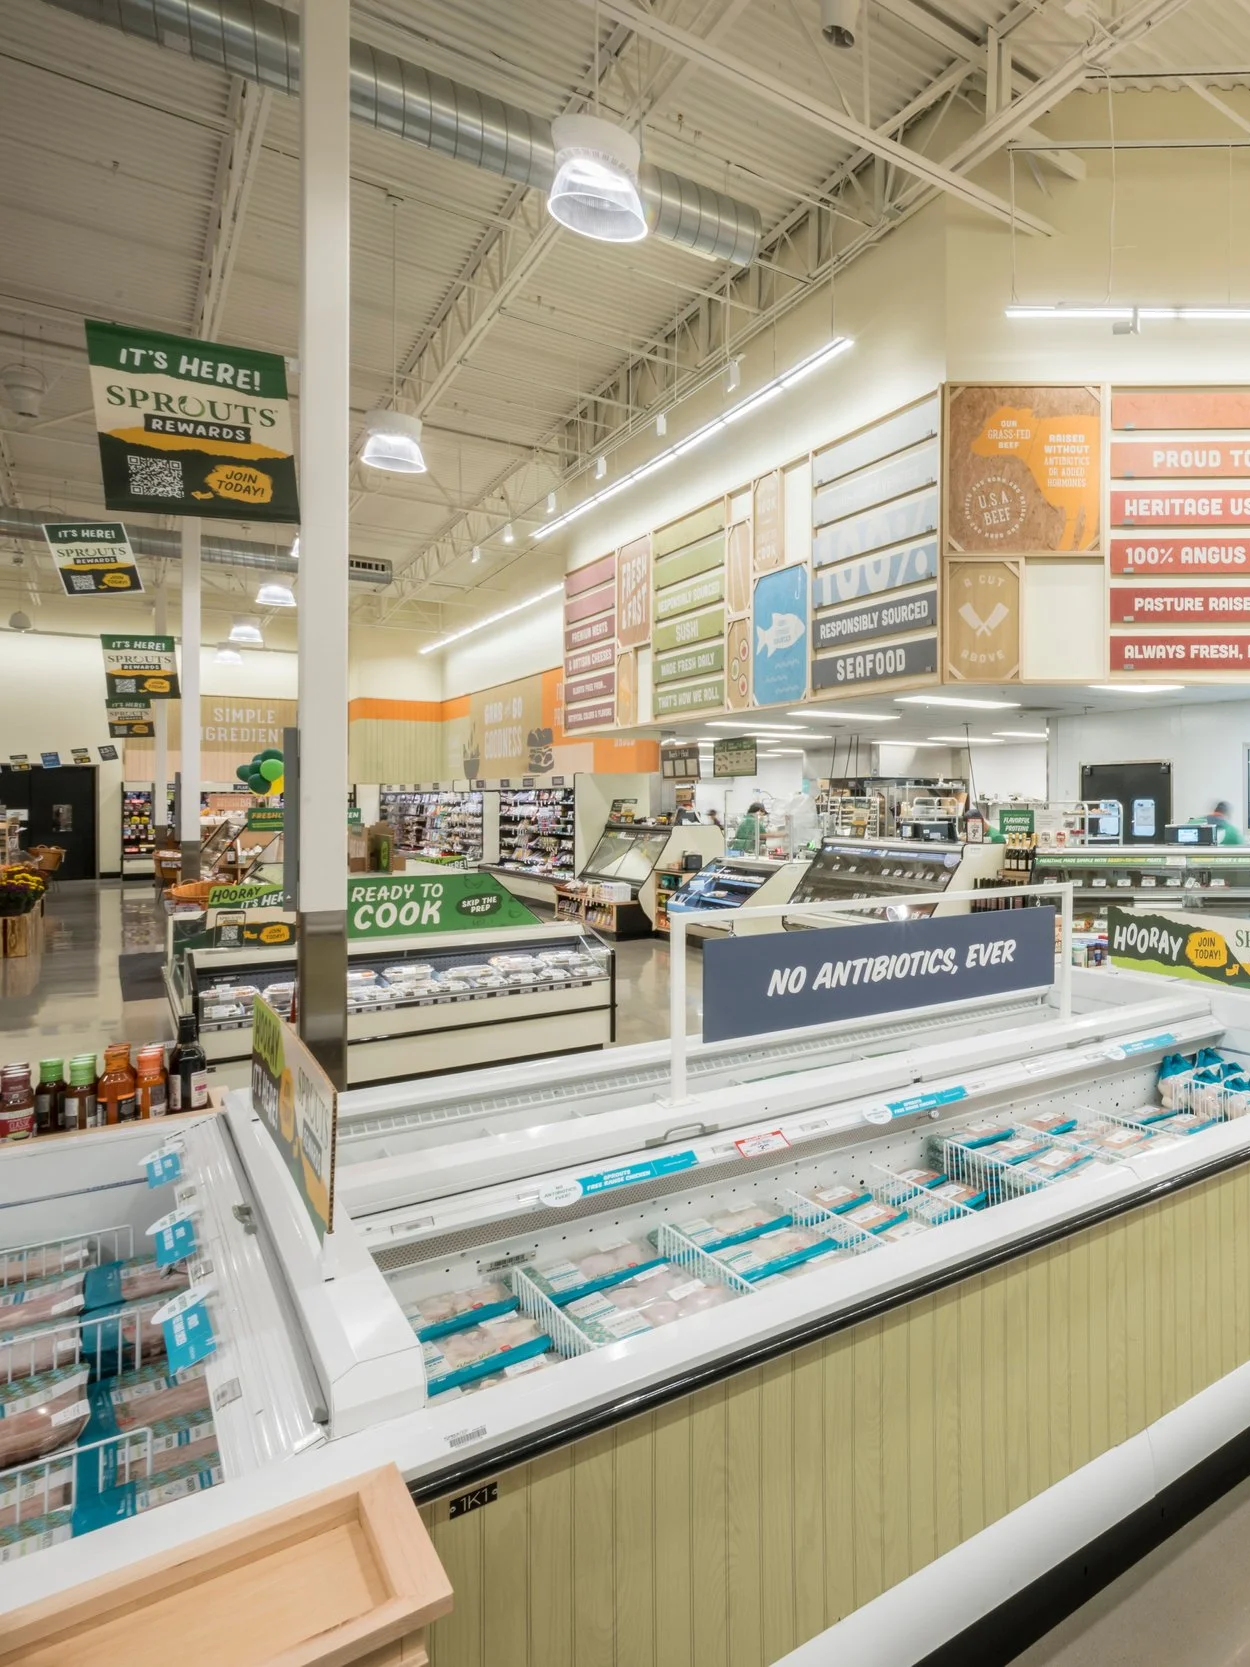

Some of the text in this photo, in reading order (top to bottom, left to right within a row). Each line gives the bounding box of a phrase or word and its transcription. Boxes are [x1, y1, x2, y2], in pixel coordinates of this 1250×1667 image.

[119, 348, 260, 391] IT'S HERE!
[106, 385, 276, 427] SPROUTS
[151, 418, 246, 441] REWARDS
[1049, 434, 1084, 442] RAISED
[1044, 445, 1090, 454] WITHOUT
[1044, 456, 1090, 466] ANTIBIOTICS
[1153, 450, 1221, 468] PROUD
[226, 470, 258, 484] JOIN
[1048, 478, 1086, 488] HORMONES
[216, 480, 265, 498] TODAY!
[978, 490, 1012, 508] U.S.A.
[1124, 498, 1222, 516] HERITAGE
[984, 507, 1010, 526] BEEF
[58, 530, 116, 539] IT'S HERE!
[57, 546, 127, 558] SPROUTS
[818, 499, 928, 606] 100%
[1126, 546, 1174, 564] 100%
[1181, 546, 1246, 564] ANGUS
[979, 574, 1005, 587] CUT
[1134, 597, 1204, 612] PASTURE
[820, 612, 878, 640] RESPONSIBLY
[882, 600, 928, 626] SOURCED
[134, 642, 165, 650] HERE!
[1124, 644, 1185, 659] ALWAYS
[1190, 644, 1244, 660] FRESH,
[678, 656, 697, 672] FRESH
[698, 652, 715, 668] DAILY
[837, 649, 906, 680] SEAFOOD
[961, 649, 1005, 664] ABOVE
[679, 692, 692, 706] HOW
[704, 686, 720, 701] ROLL
[214, 708, 276, 724] SIMPLE
[211, 887, 261, 902] HOORAY
[241, 892, 284, 908] IT'S HER
[351, 883, 444, 902] READY TO
[462, 895, 498, 908] SKIP THE
[470, 904, 490, 913] PREP
[353, 900, 442, 930] COOK
[1114, 922, 1183, 961] HOORAY
[1198, 937, 1216, 948] JOIN
[1195, 948, 1220, 960] TODAY!
[767, 938, 1016, 996] NO ANTIBIOTICS, EVER
[587, 1183, 602, 1191] FREE
[604, 1177, 625, 1186] RANGE
[461, 1488, 488, 1512] 1K1
